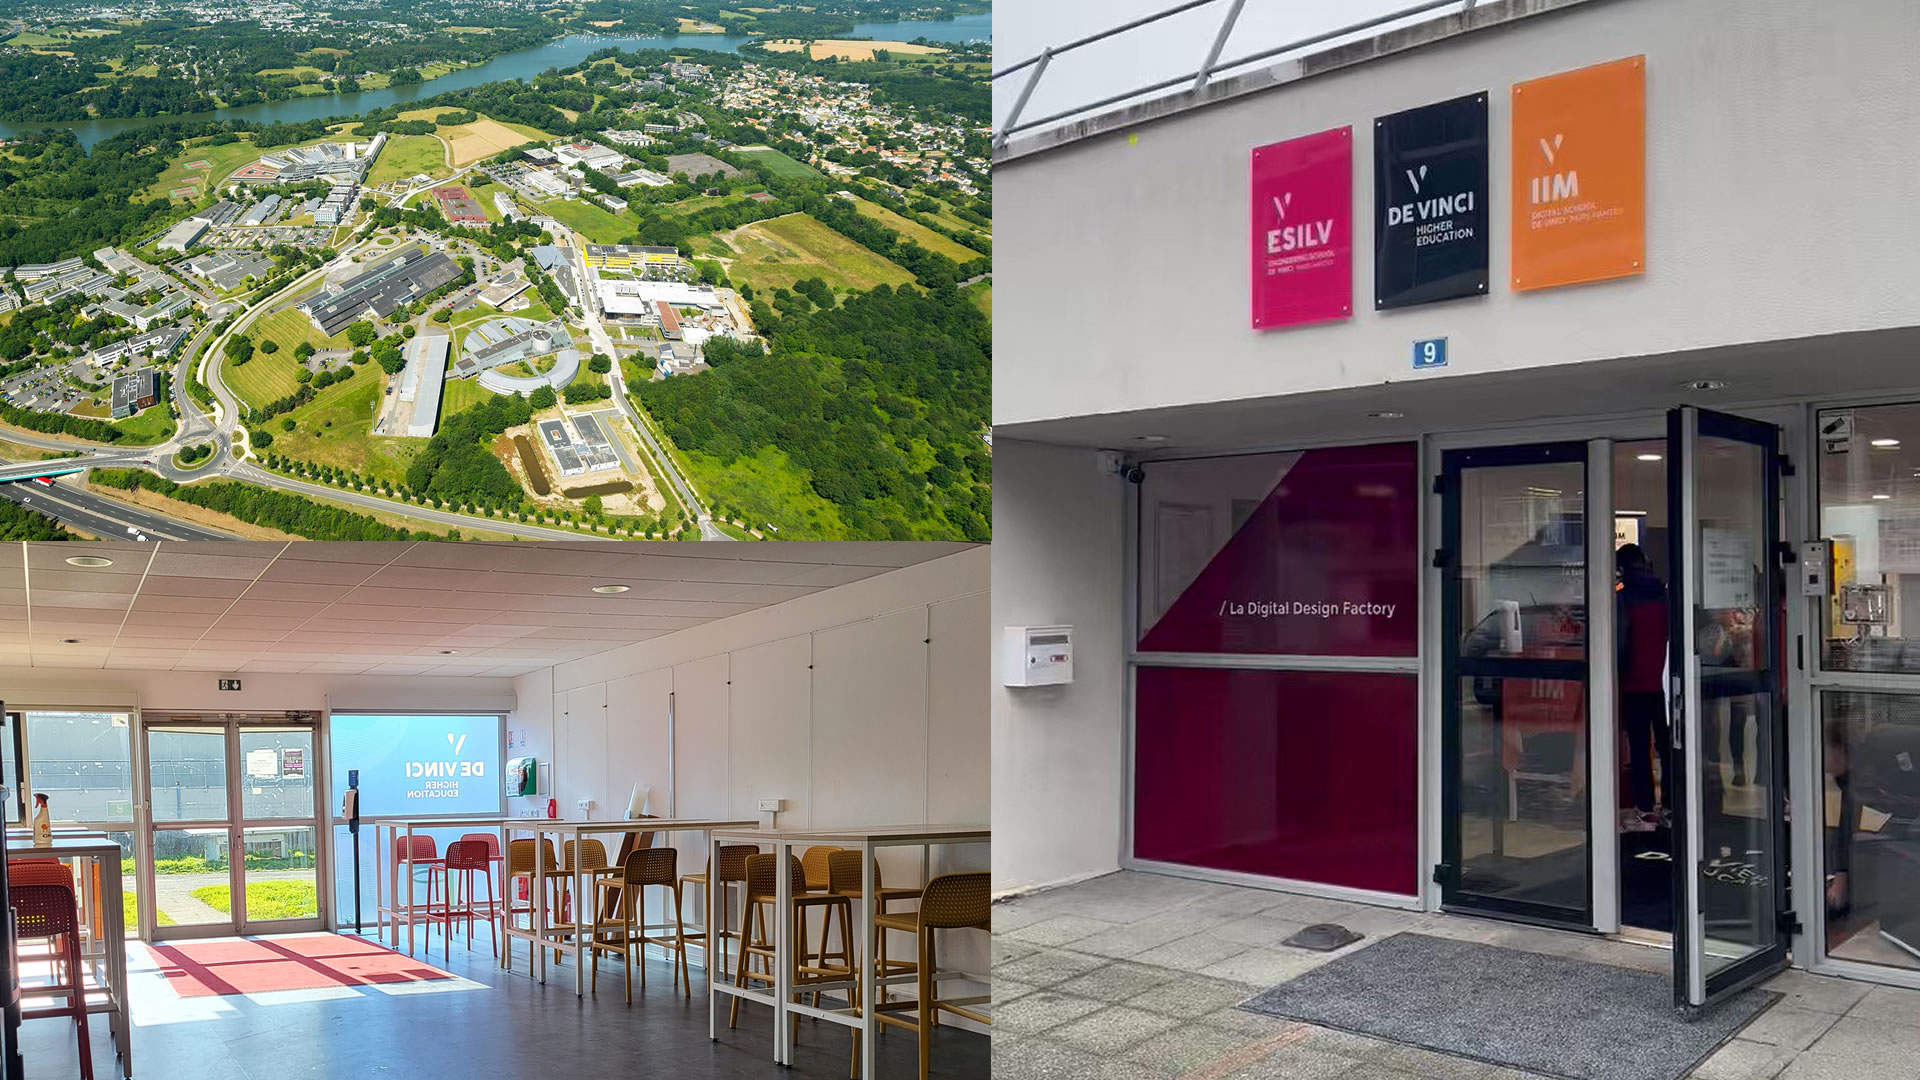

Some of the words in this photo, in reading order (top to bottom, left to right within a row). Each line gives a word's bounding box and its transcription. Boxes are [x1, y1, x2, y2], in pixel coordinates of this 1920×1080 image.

[1531, 170, 1579, 204] IIM
[1388, 203, 1414, 226] DE
[1417, 191, 1474, 220] VINCI
[1267, 219, 1333, 253] ESILV
[1416, 220, 1454, 236] HIGHER
[1416, 227, 1474, 247] EDUCATION
[1424, 342, 1436, 363] 9
[1230, 602, 1244, 615] La
[1248, 602, 1289, 618] Digital
[1293, 602, 1339, 618] Design
[1343, 601, 1396, 618] Factory
